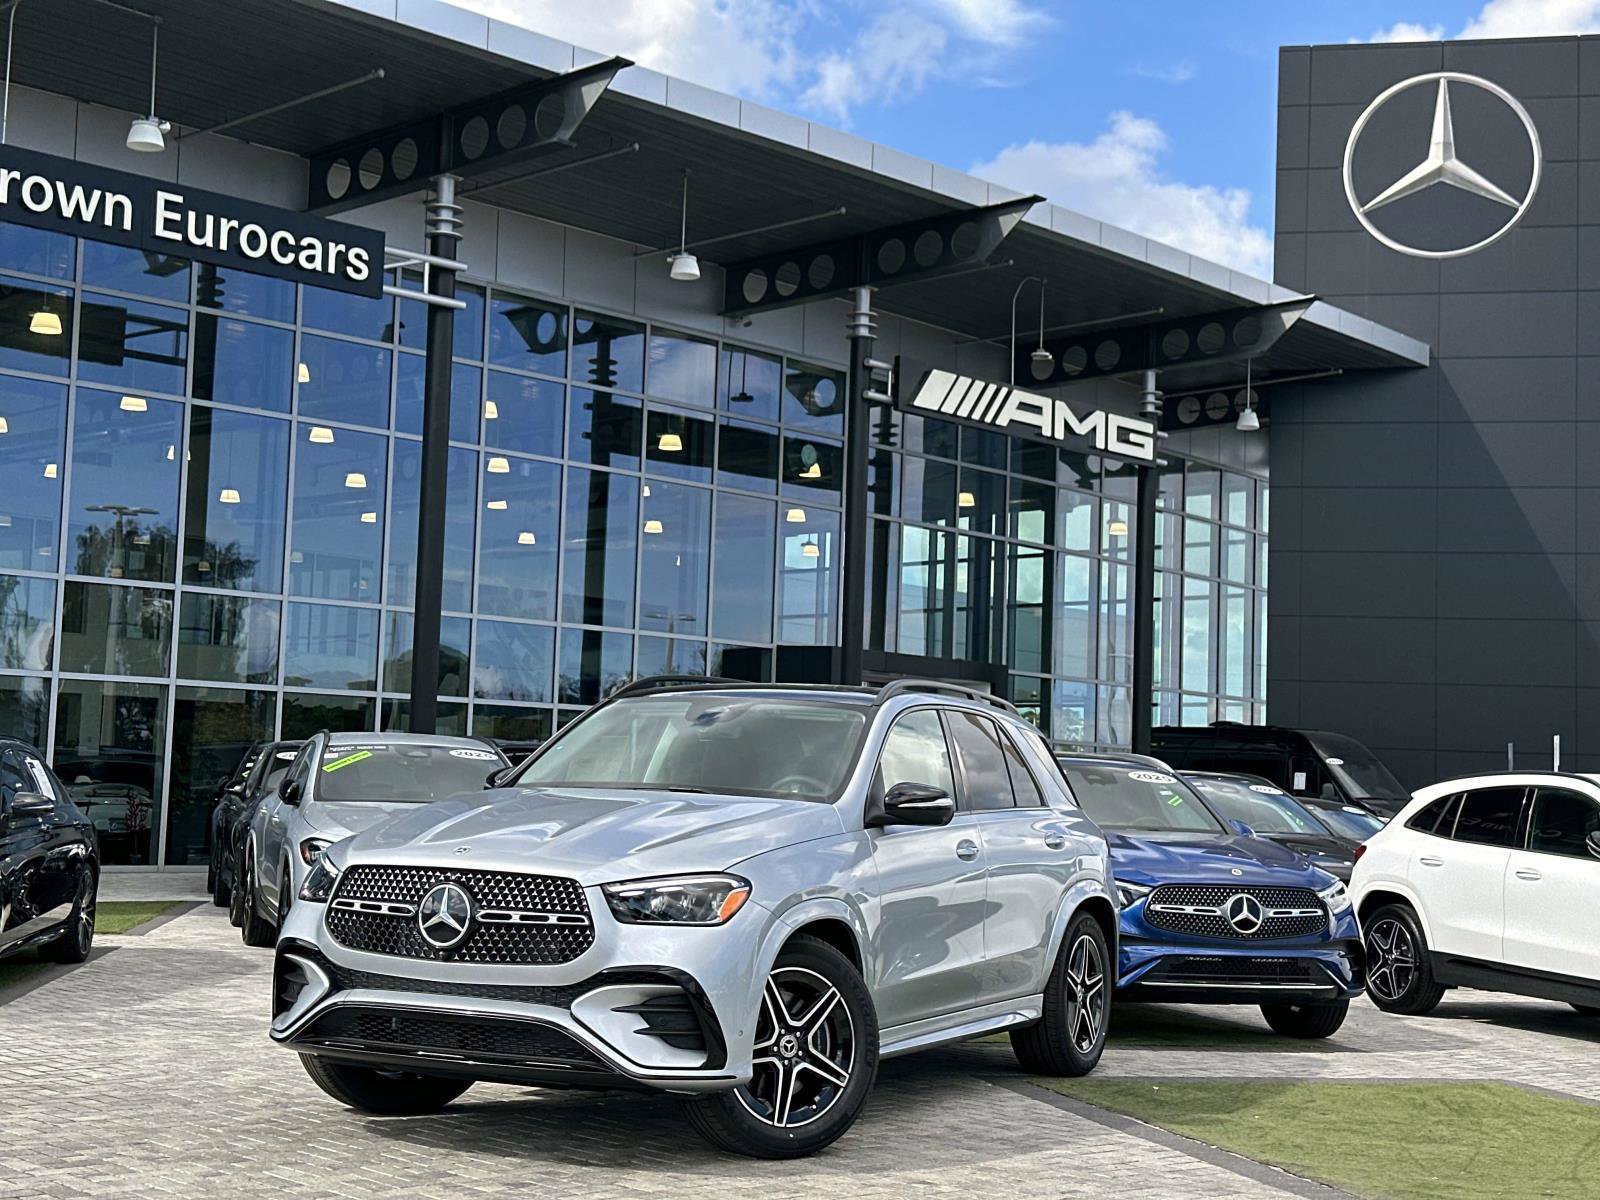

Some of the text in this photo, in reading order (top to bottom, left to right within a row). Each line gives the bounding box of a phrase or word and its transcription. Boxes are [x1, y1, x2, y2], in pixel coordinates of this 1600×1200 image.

[0, 168, 370, 281] rown Eurocars
[995, 388, 1154, 461] AMG
[1133, 772, 1172, 782] 2025
